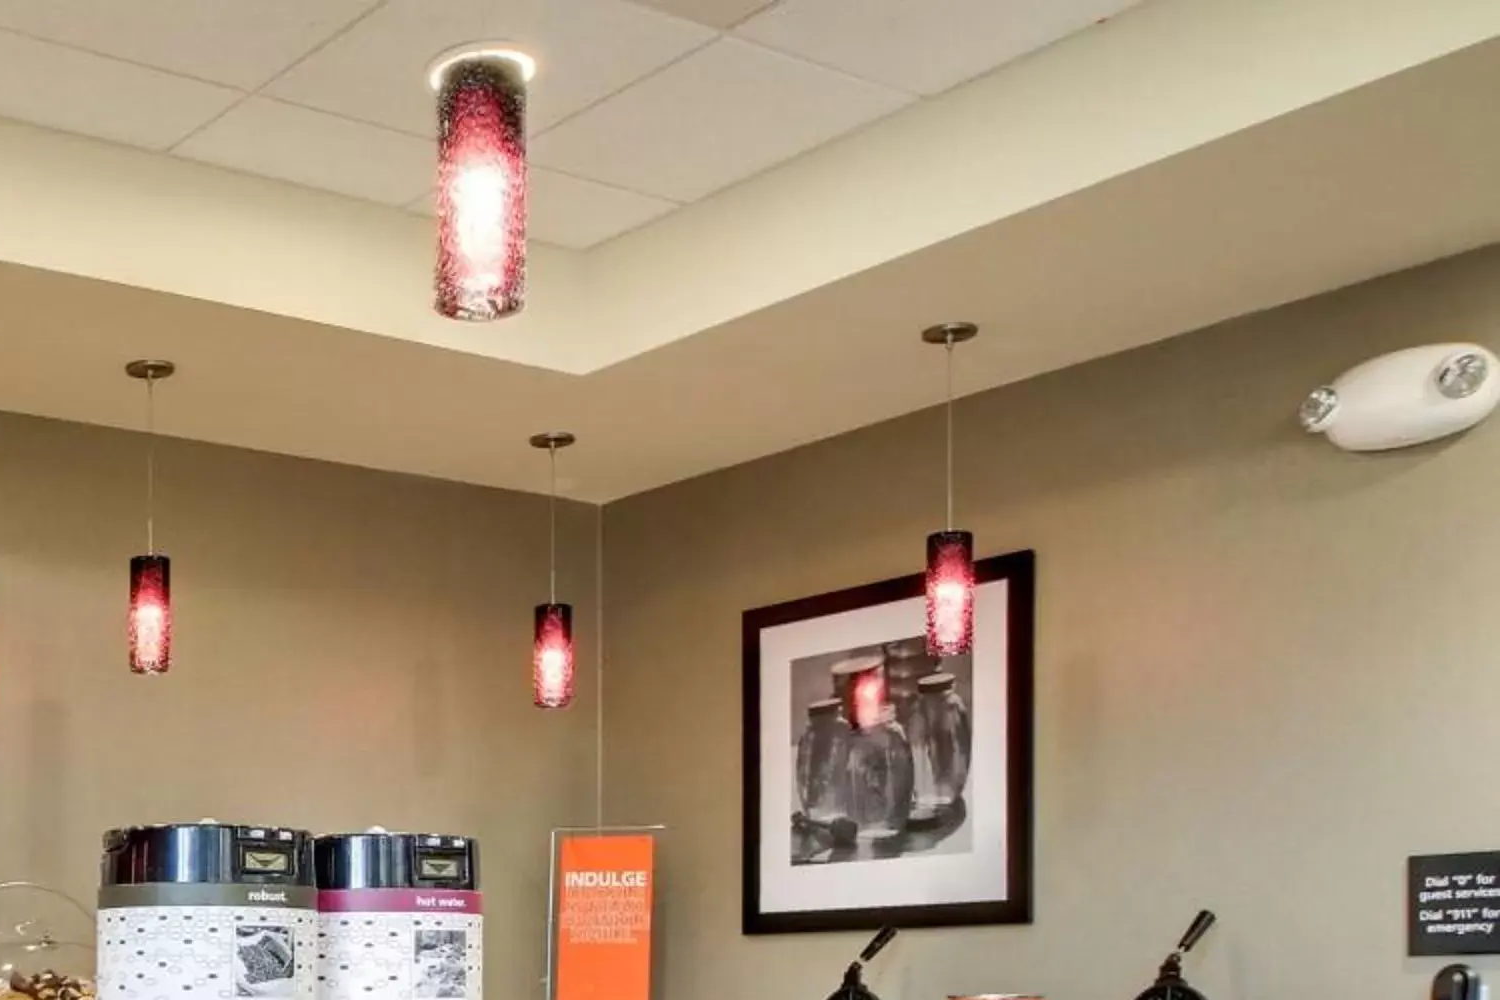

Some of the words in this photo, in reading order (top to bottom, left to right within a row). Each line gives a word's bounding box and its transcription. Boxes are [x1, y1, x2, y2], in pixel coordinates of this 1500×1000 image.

[565, 871, 646, 888] INDULGE
[1425, 875, 1449, 888] Dial
[1476, 873, 1496, 885] for
[1419, 889, 1452, 903] guest
[1419, 909, 1443, 921] Dial
[1427, 923, 1493, 934] emergency
